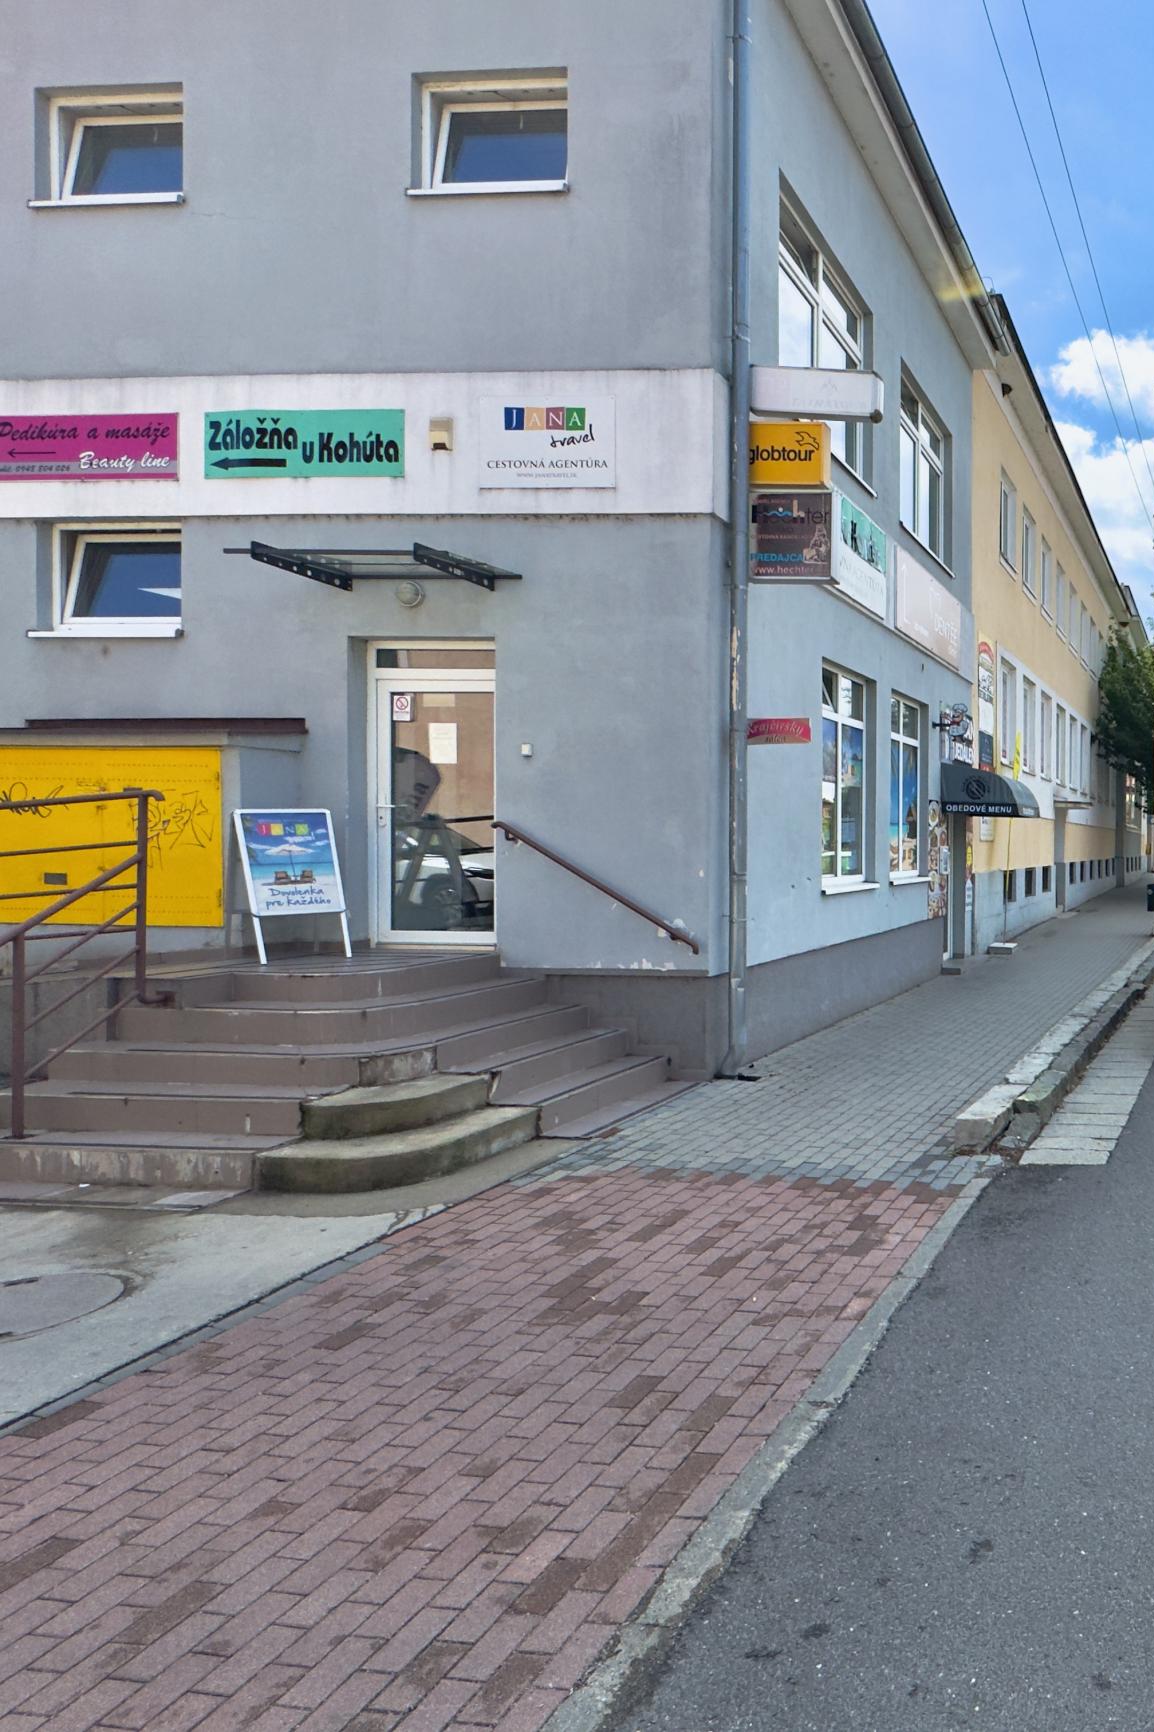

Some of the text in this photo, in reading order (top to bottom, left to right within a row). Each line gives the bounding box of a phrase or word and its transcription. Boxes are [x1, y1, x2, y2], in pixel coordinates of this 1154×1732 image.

[508, 408, 584, 430] JANA
[0, 421, 170, 445] Pedikúra a masáže
[208, 417, 400, 464] Záložňa u Kohúta
[550, 424, 595, 448] travel
[79, 451, 170, 473] Beauty line
[487, 457, 608, 469] CESTOVNÁ AGENTÚRA
[749, 446, 815, 465] globtour
[946, 803, 1012, 813] OBEDOVÉ MENU
